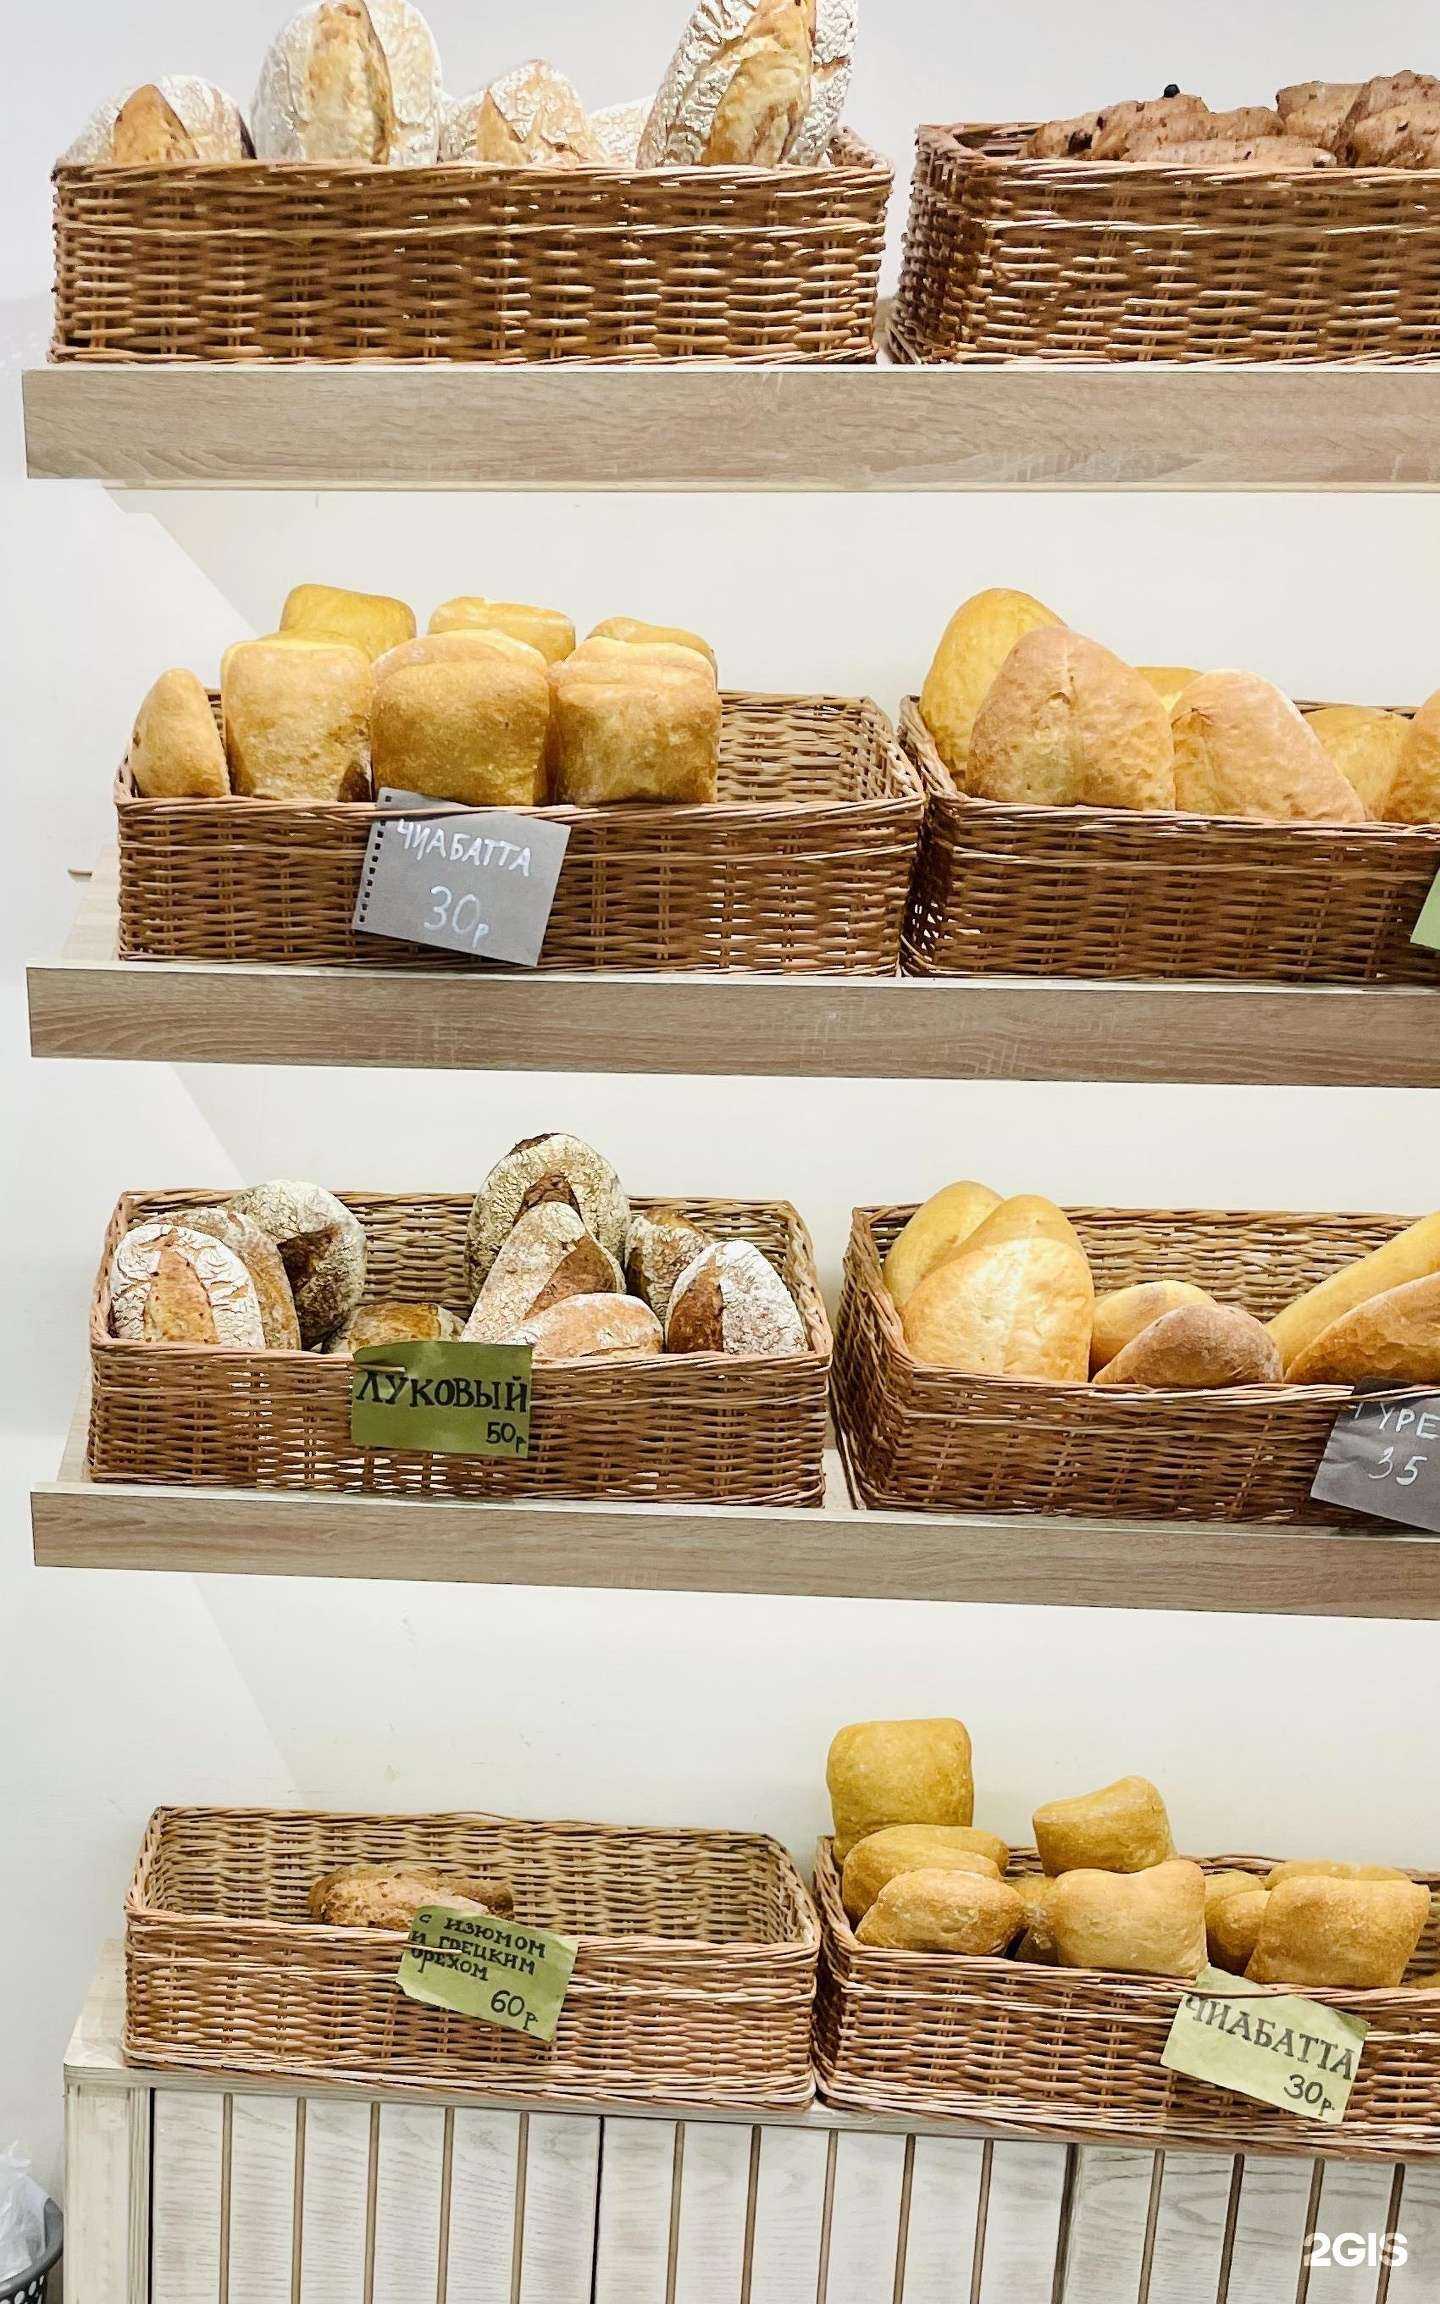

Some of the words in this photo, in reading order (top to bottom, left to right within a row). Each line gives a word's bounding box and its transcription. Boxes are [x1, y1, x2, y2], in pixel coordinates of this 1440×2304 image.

[397, 819, 531, 877] ЧИАБАТТА
[355, 1371, 528, 1413] ЛУКОВЫЙ
[1368, 1446, 1428, 1485] 35
[443, 1917, 545, 1958] ИЗЮМОМ
[1186, 1995, 1355, 2080] ЧИАБАТТА
